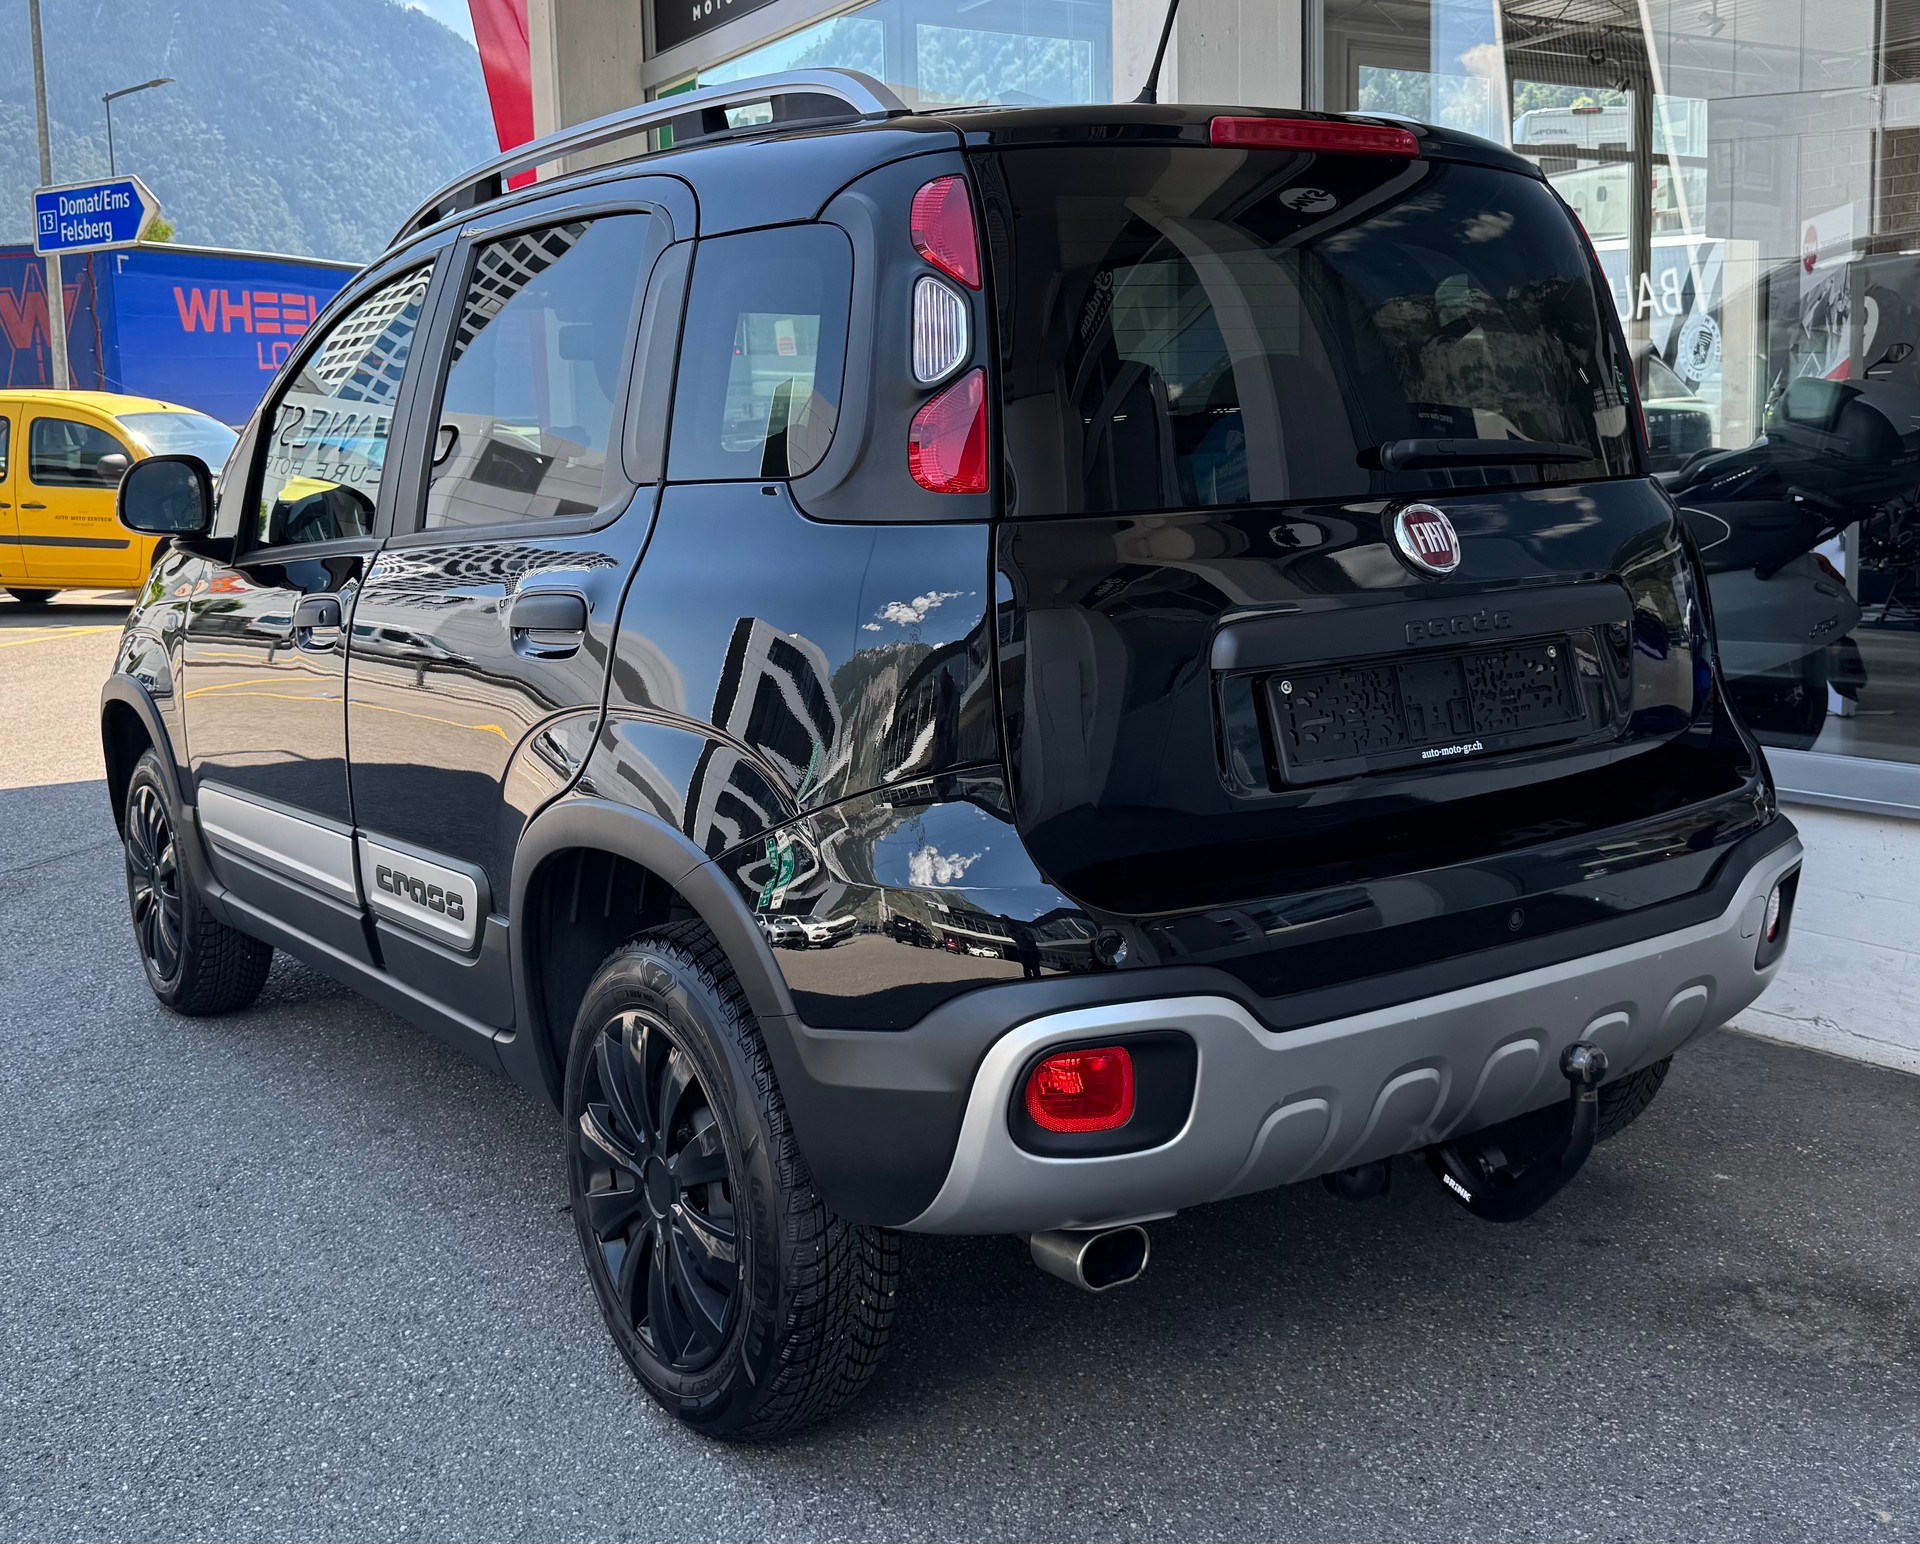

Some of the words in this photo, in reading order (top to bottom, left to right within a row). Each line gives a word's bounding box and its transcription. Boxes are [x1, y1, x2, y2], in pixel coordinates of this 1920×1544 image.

[59, 190, 130, 217] Domat/Ems
[41, 214, 54, 231] 13
[60, 219, 113, 243] Felsberg
[257, 341, 297, 370] LO
[1410, 521, 1450, 555] FIAT
[1405, 610, 1513, 646] panda
[1421, 740, 1484, 760] auto-moto-gr.ch
[375, 864, 465, 922] cross
